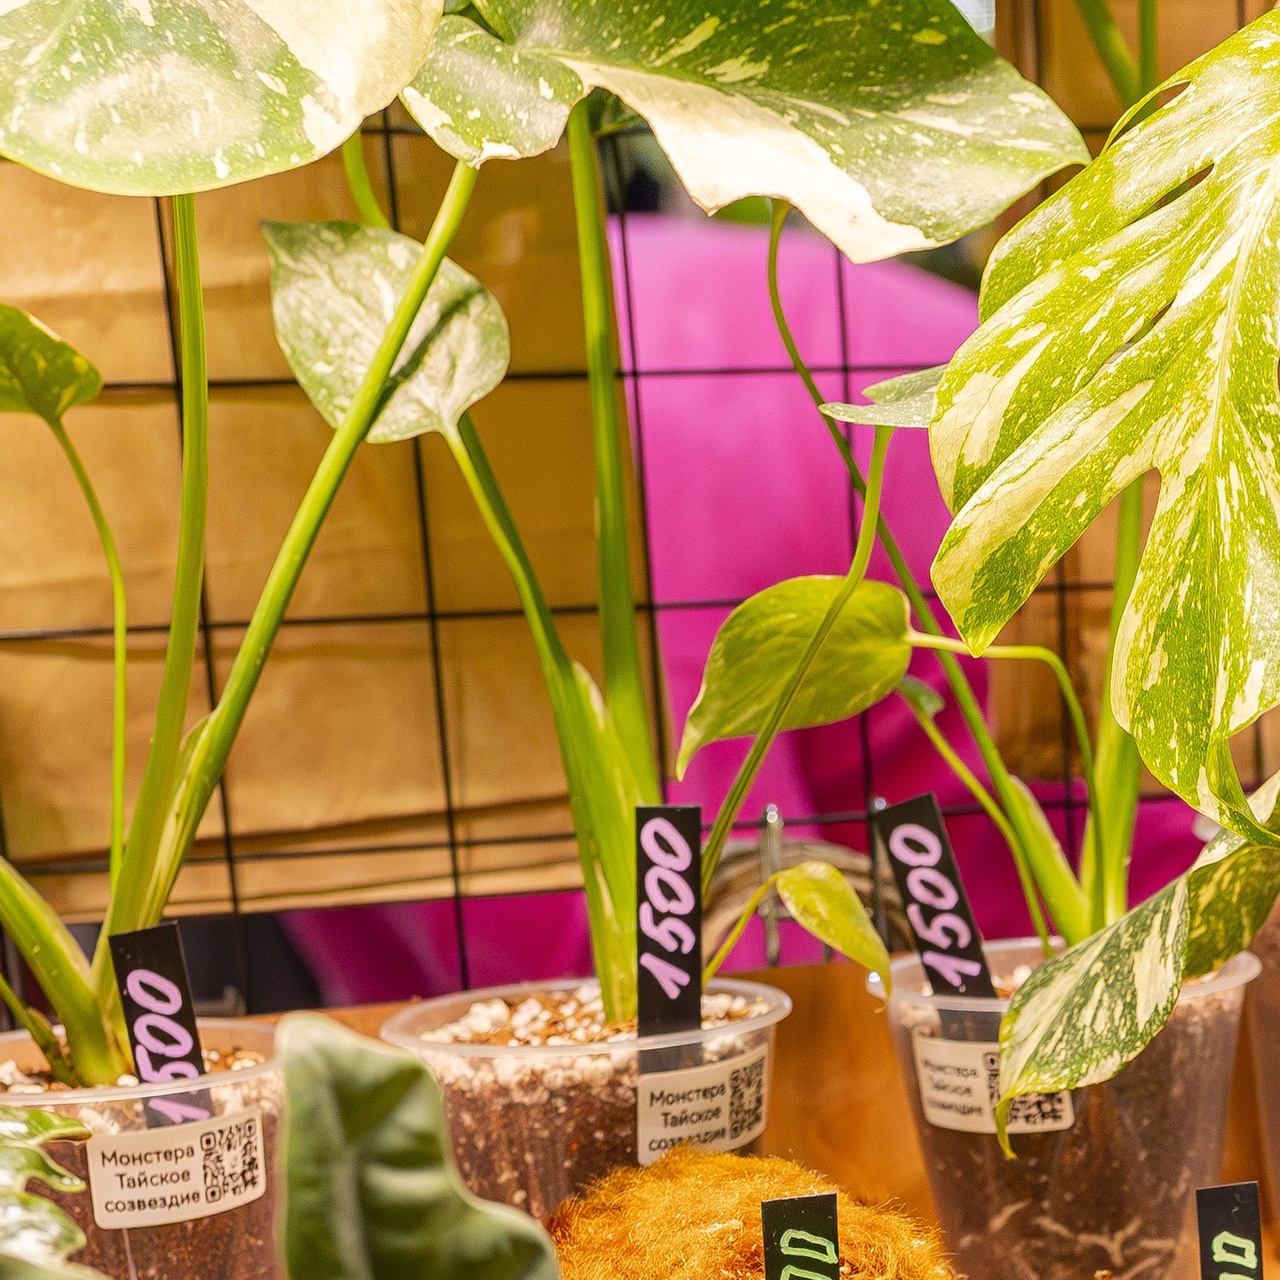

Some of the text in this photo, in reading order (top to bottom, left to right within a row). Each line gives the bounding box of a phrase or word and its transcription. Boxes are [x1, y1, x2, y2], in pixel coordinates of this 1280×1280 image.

[640, 817, 696, 1000] 1500
[889, 823, 982, 988] 1500
[650, 1082, 726, 1106] Монстера
[661, 1106, 722, 1129] Тайское
[101, 1145, 195, 1168] Монстера
[115, 1167, 191, 1191] Тайское
[104, 1190, 201, 1214] созвездие
